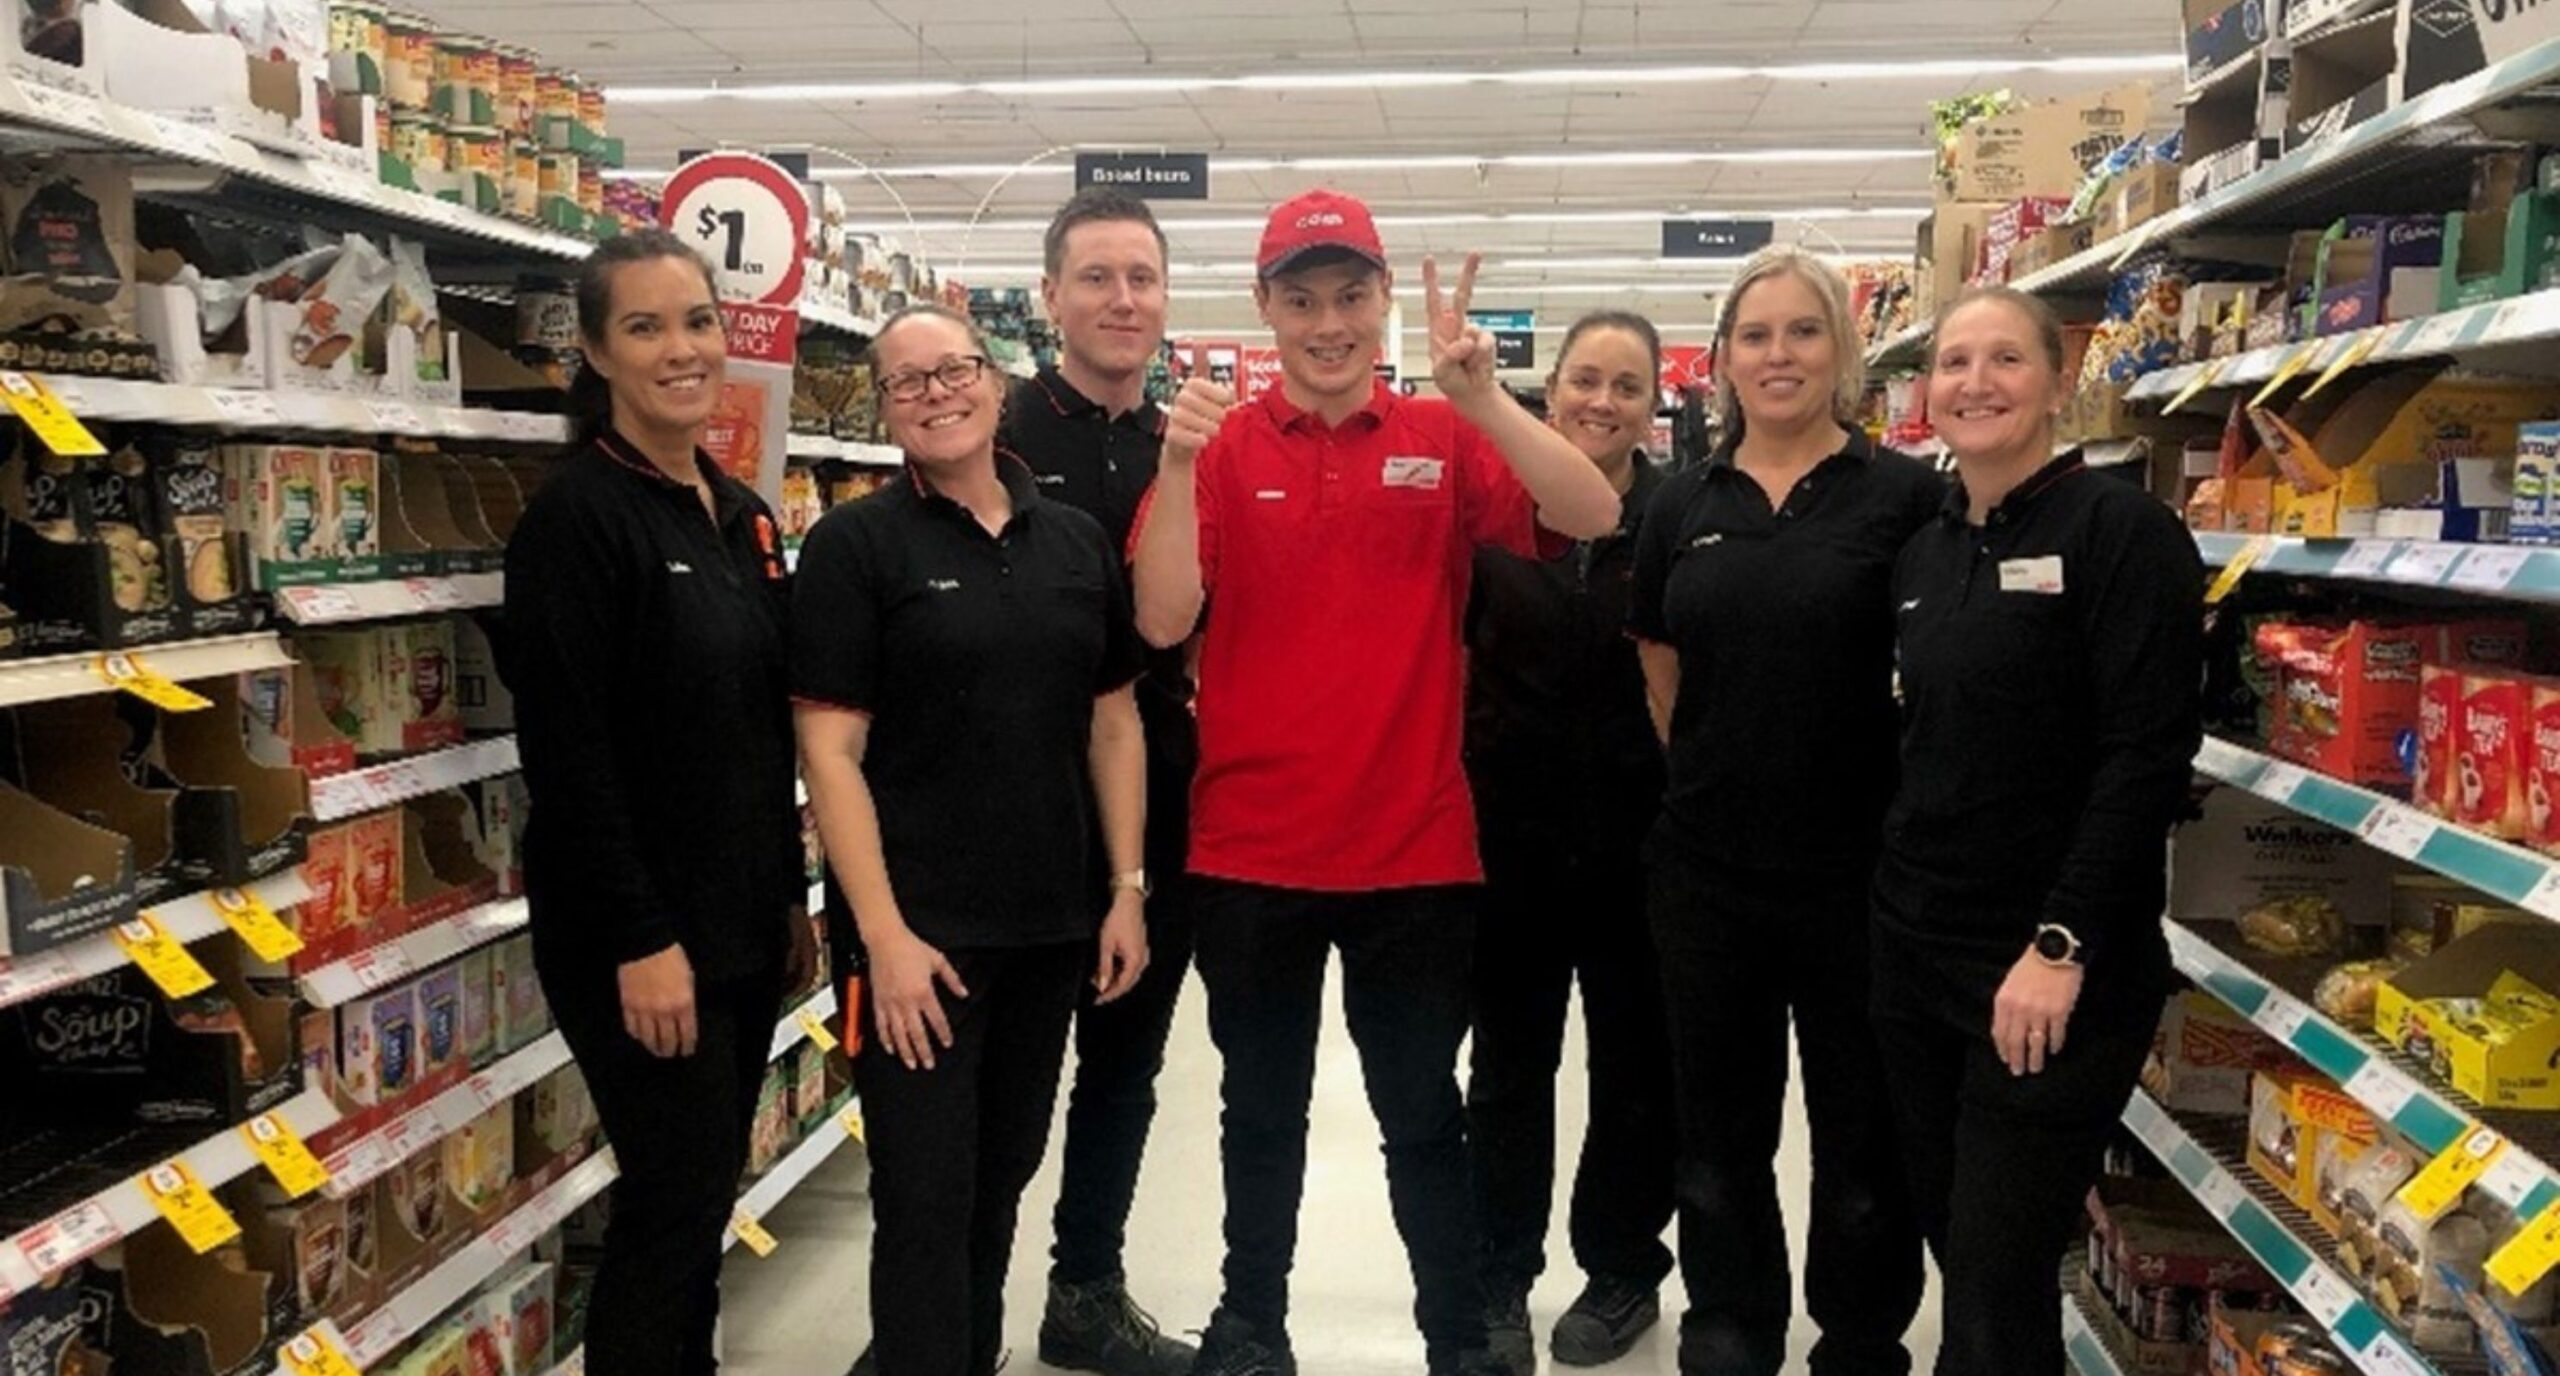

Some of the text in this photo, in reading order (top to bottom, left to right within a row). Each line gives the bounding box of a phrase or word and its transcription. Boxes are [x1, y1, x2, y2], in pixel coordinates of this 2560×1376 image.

[697, 204, 744, 270] $1
[739, 311, 781, 333] DAY
[2245, 825, 2353, 846] Walkers
[36, 1005, 140, 1051] Soup
